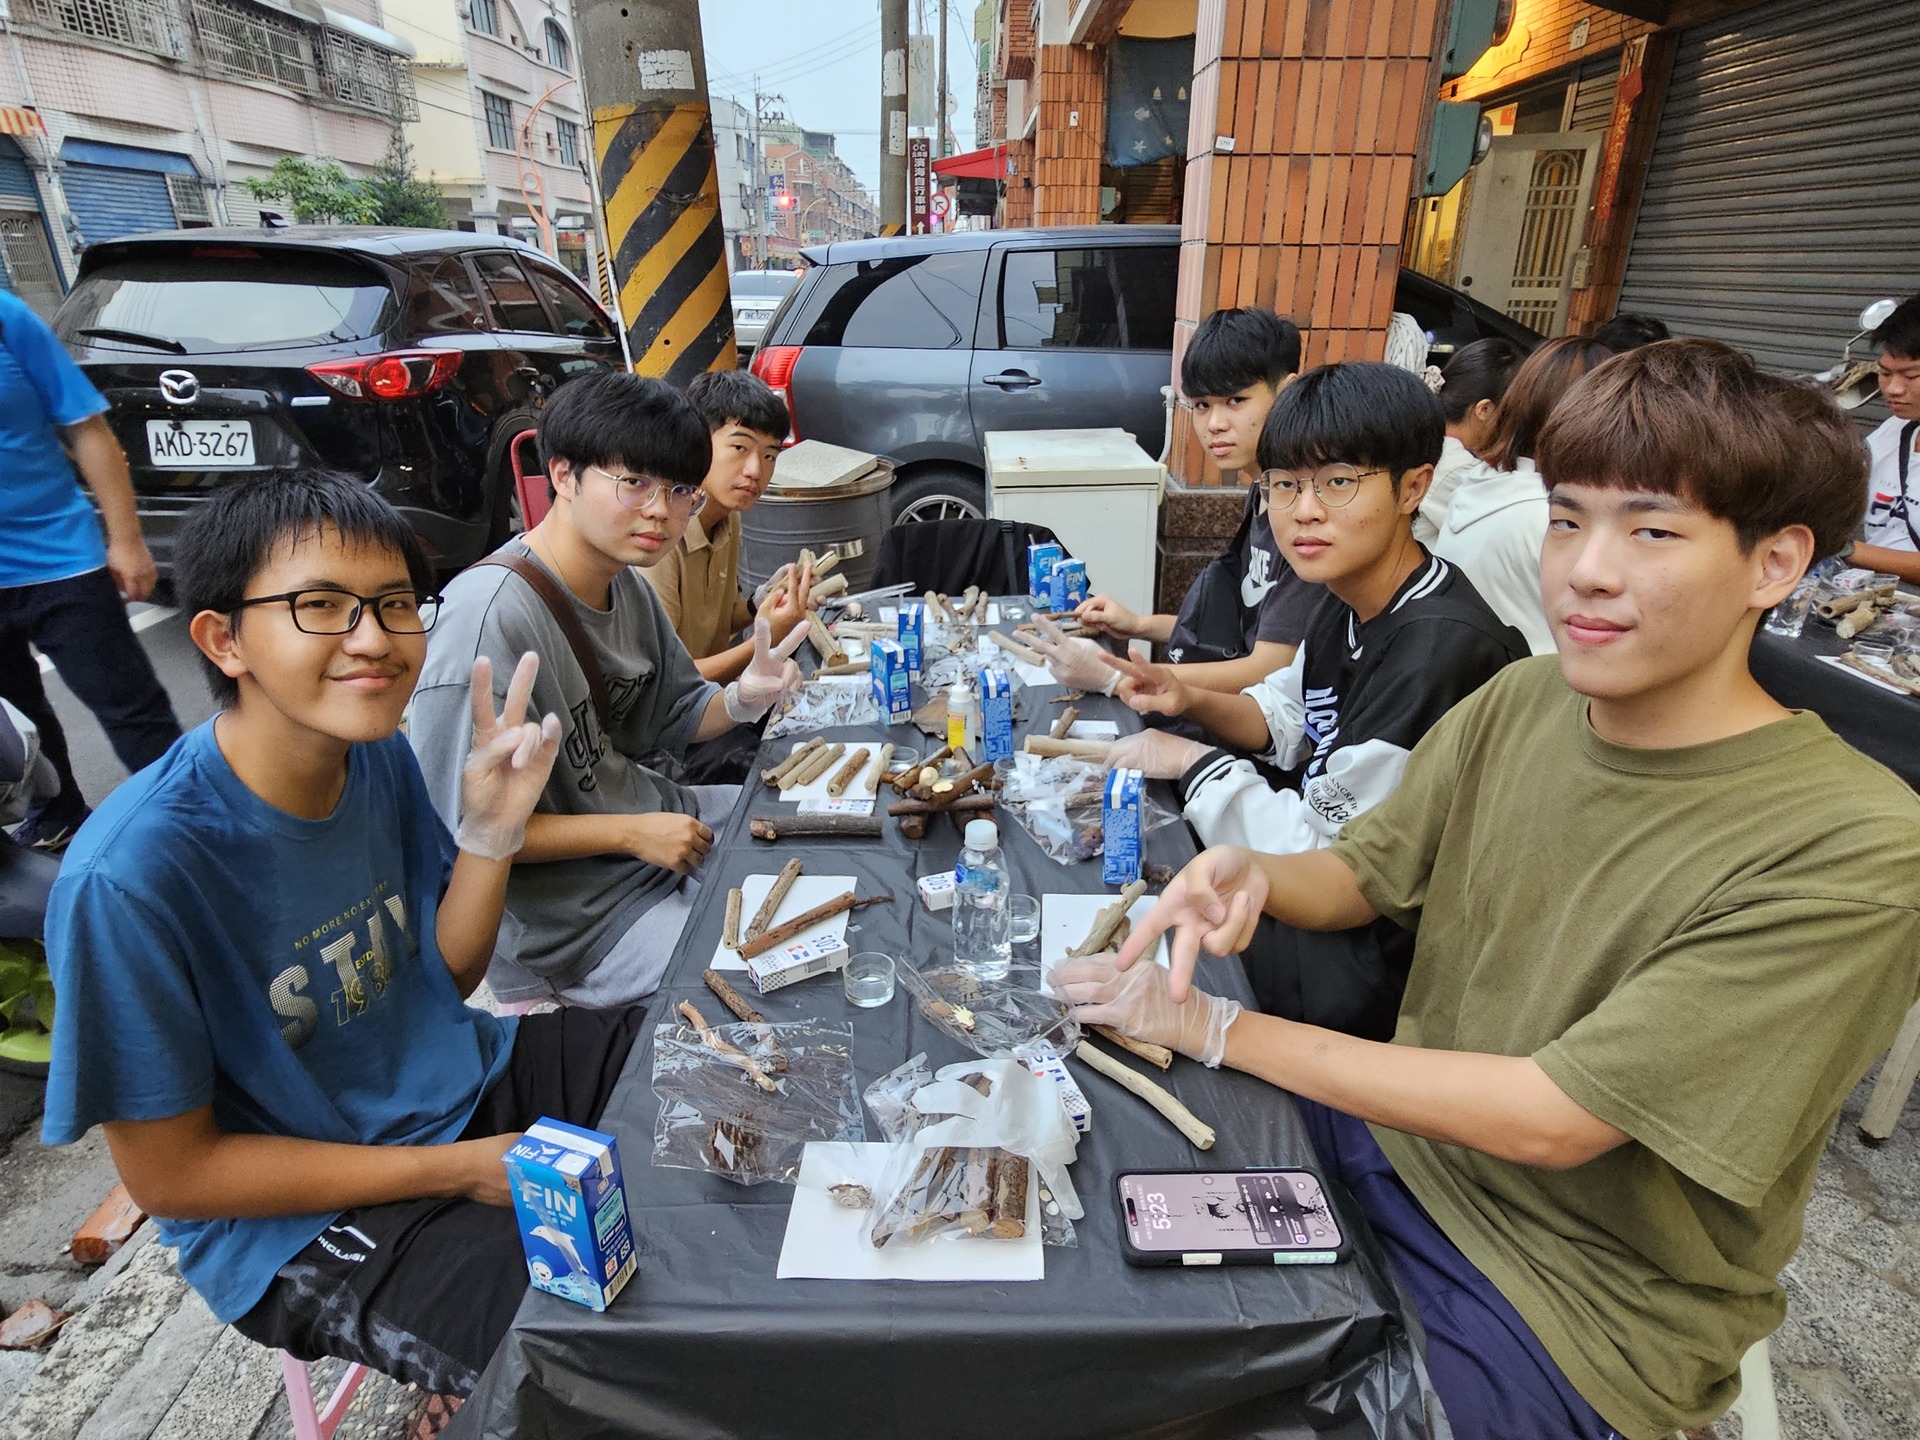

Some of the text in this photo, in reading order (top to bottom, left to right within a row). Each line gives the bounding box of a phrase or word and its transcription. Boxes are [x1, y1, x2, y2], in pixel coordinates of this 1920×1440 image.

[154, 431, 249, 457] AKD-3267
[294, 936, 310, 950] NO
[312, 917, 343, 940] MORE
[344, 905, 358, 920] NO
[811, 934, 842, 954] 502
[510, 1143, 541, 1160] FIN
[522, 1180, 577, 1218] FIN
[1146, 1192, 1172, 1230] 5:23
